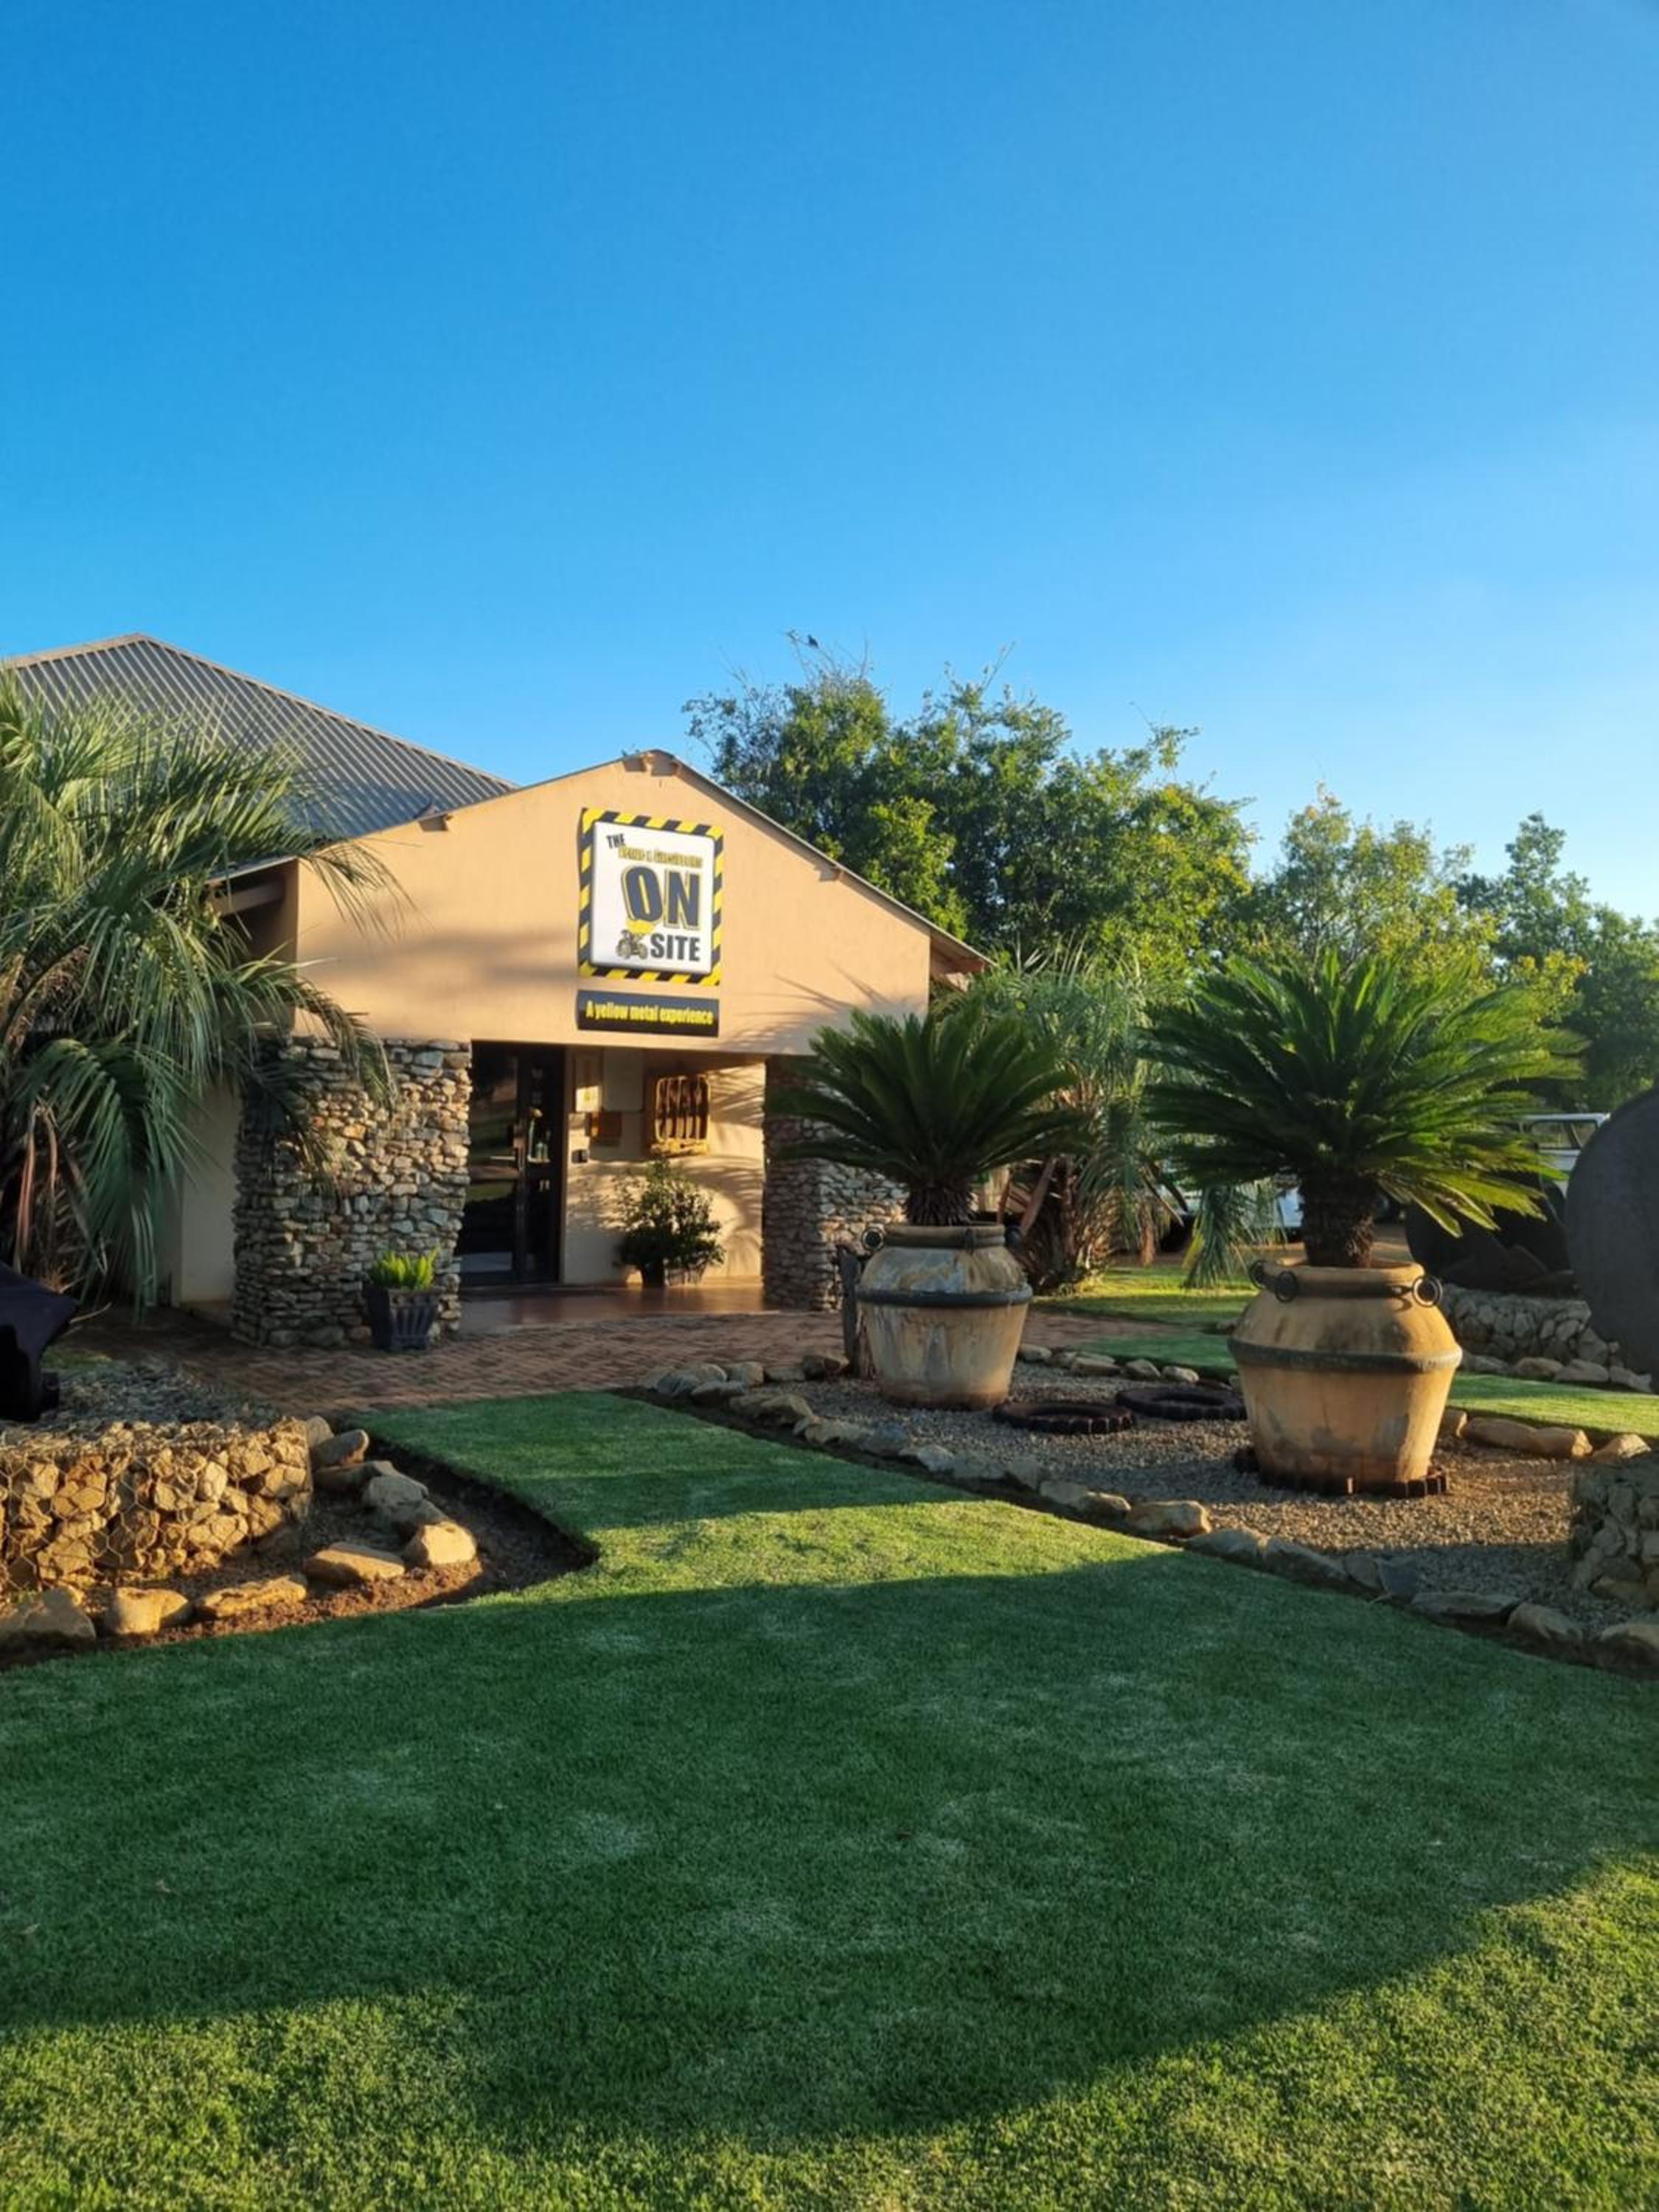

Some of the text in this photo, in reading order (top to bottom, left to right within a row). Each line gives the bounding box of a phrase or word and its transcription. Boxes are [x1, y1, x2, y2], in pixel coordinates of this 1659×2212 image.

[605, 832, 625, 849] THE
[621, 866, 700, 930] ON
[650, 933, 700, 961] SITE
[586, 1000, 713, 1026] A yellow metal experience
